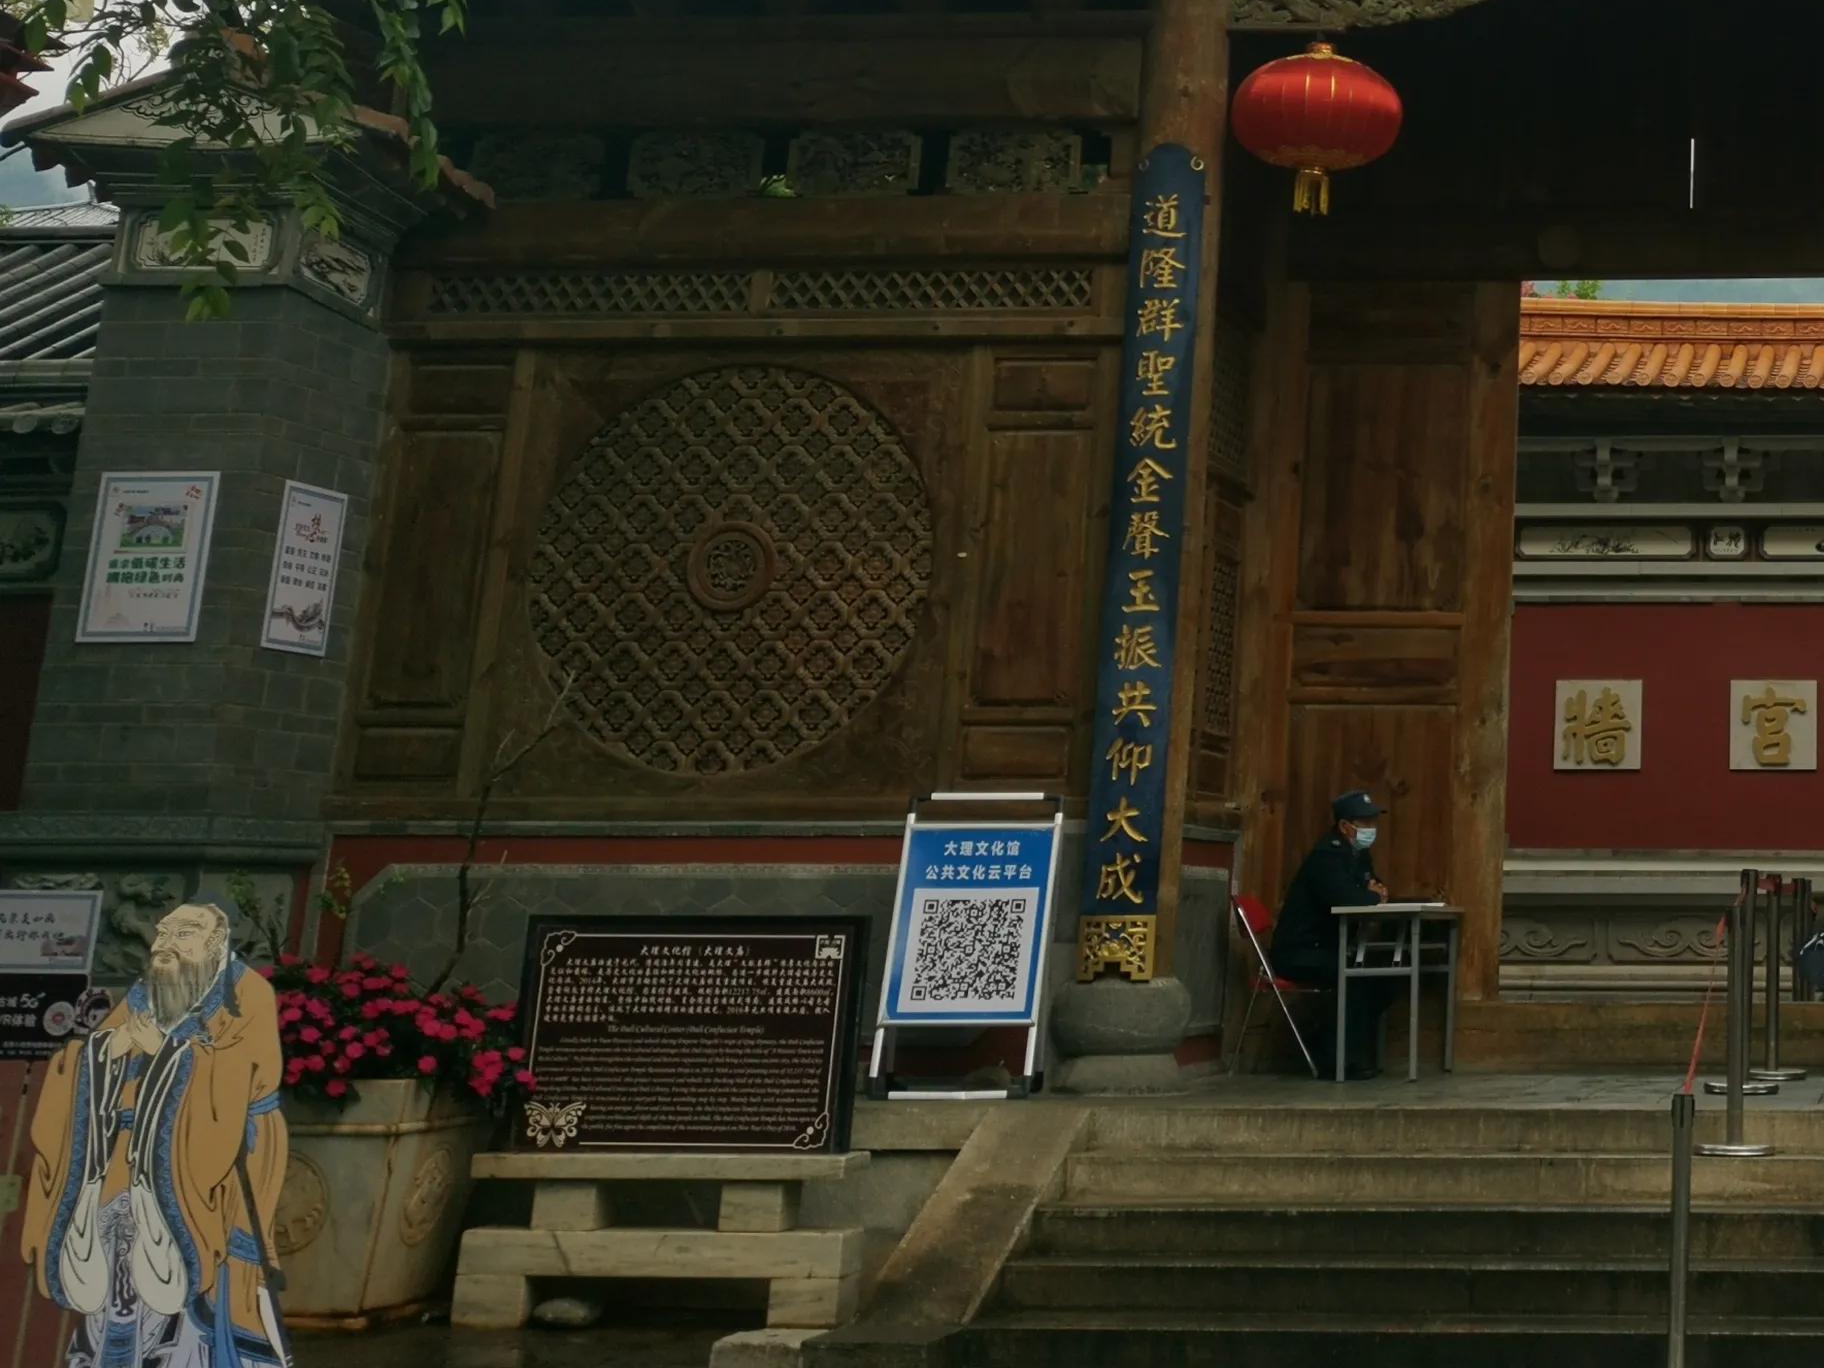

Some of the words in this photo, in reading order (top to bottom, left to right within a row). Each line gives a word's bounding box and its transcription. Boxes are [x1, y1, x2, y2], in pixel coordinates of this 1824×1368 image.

[943, 840, 1021, 856] 大理文化馆
[925, 864, 1033, 880] 公共文化云平台
